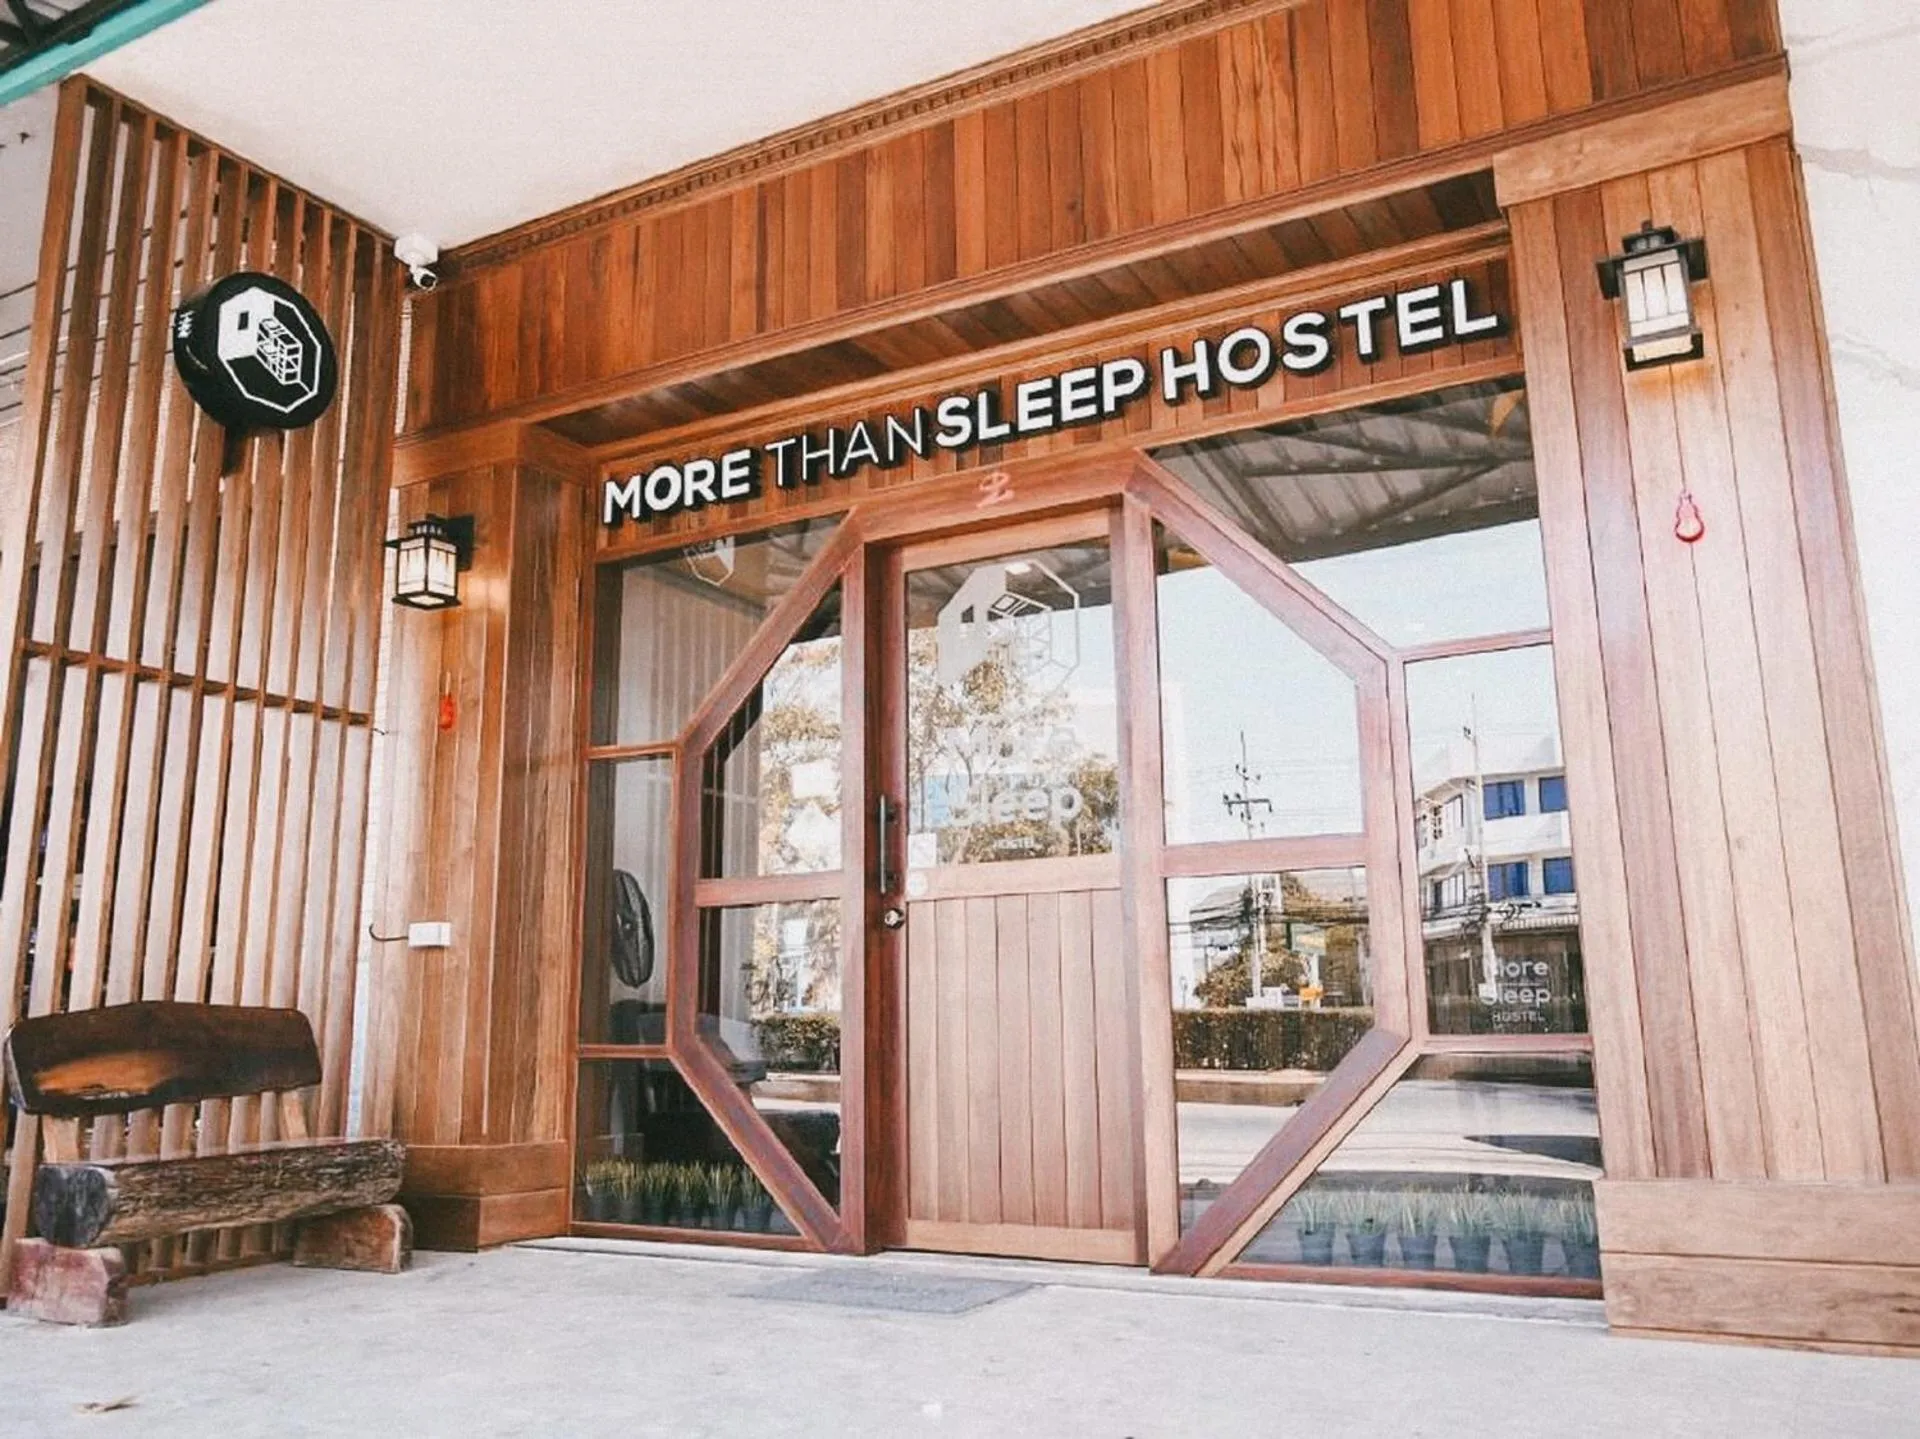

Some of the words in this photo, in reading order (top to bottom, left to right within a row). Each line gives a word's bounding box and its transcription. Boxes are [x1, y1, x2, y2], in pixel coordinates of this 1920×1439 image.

[602, 448, 752, 524] MORE
[765, 407, 923, 488] THAN
[935, 357, 1146, 449] SLEEP
[1161, 278, 1499, 401] HOSTEL
